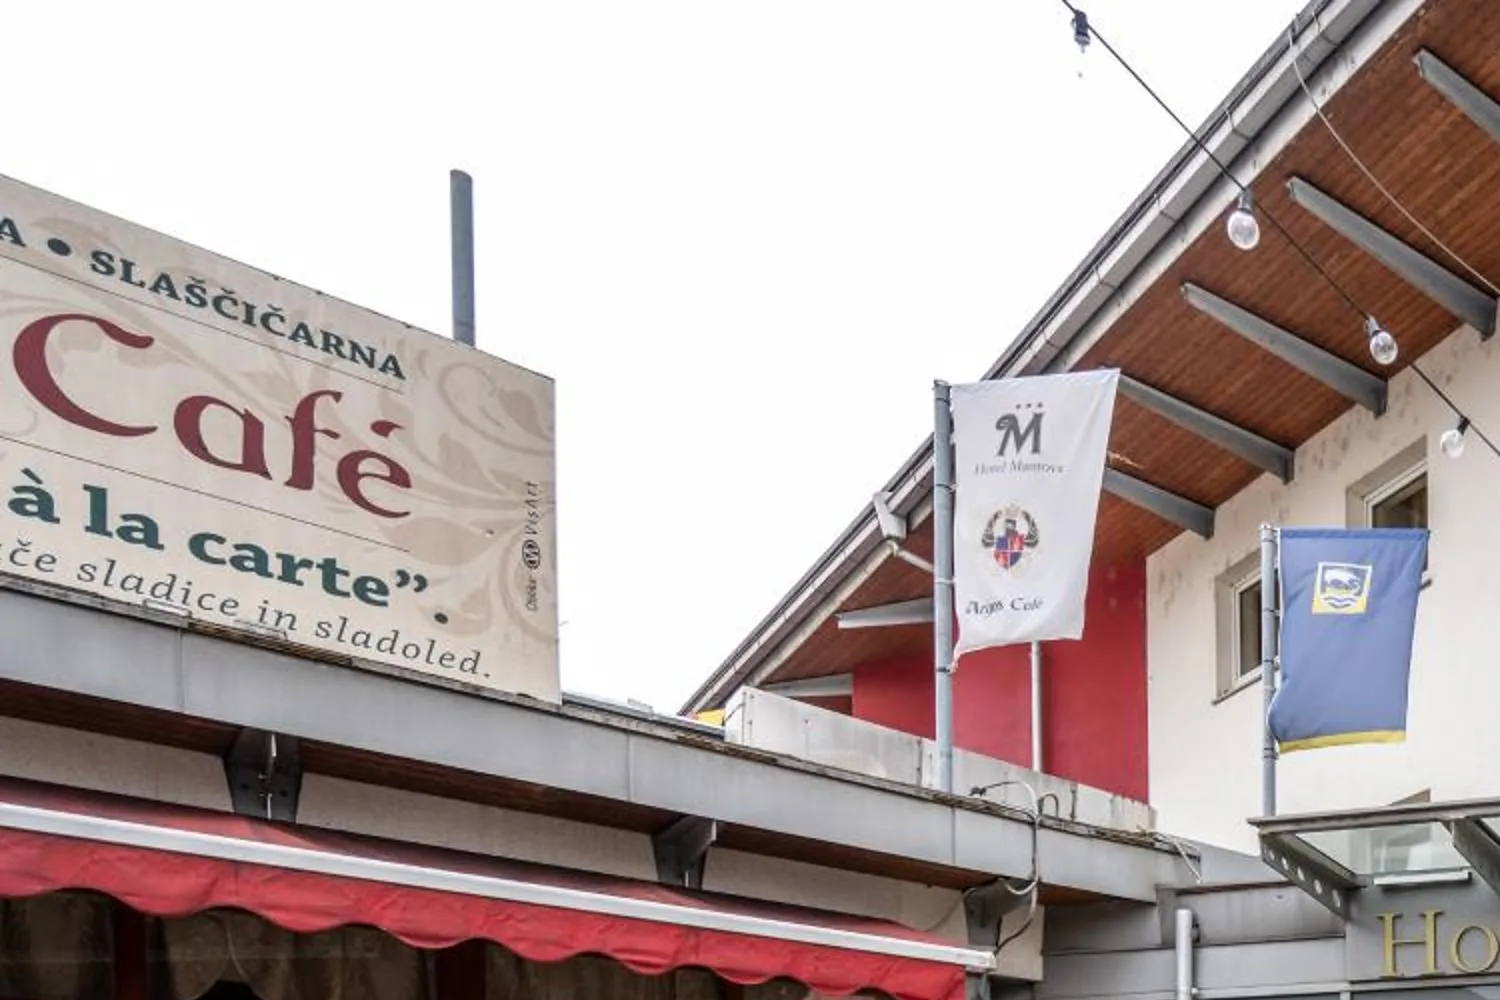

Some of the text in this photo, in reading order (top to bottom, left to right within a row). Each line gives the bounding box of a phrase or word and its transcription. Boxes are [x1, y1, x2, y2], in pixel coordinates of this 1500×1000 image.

[90, 249, 406, 380] SLAŠČIČARNA
[12, 313, 413, 518] Café
[9, 467, 60, 524] à
[82, 483, 165, 551] la
[76, 556, 241, 619] sladice
[258, 598, 298, 633] in
[314, 615, 491, 679] sladoled.
